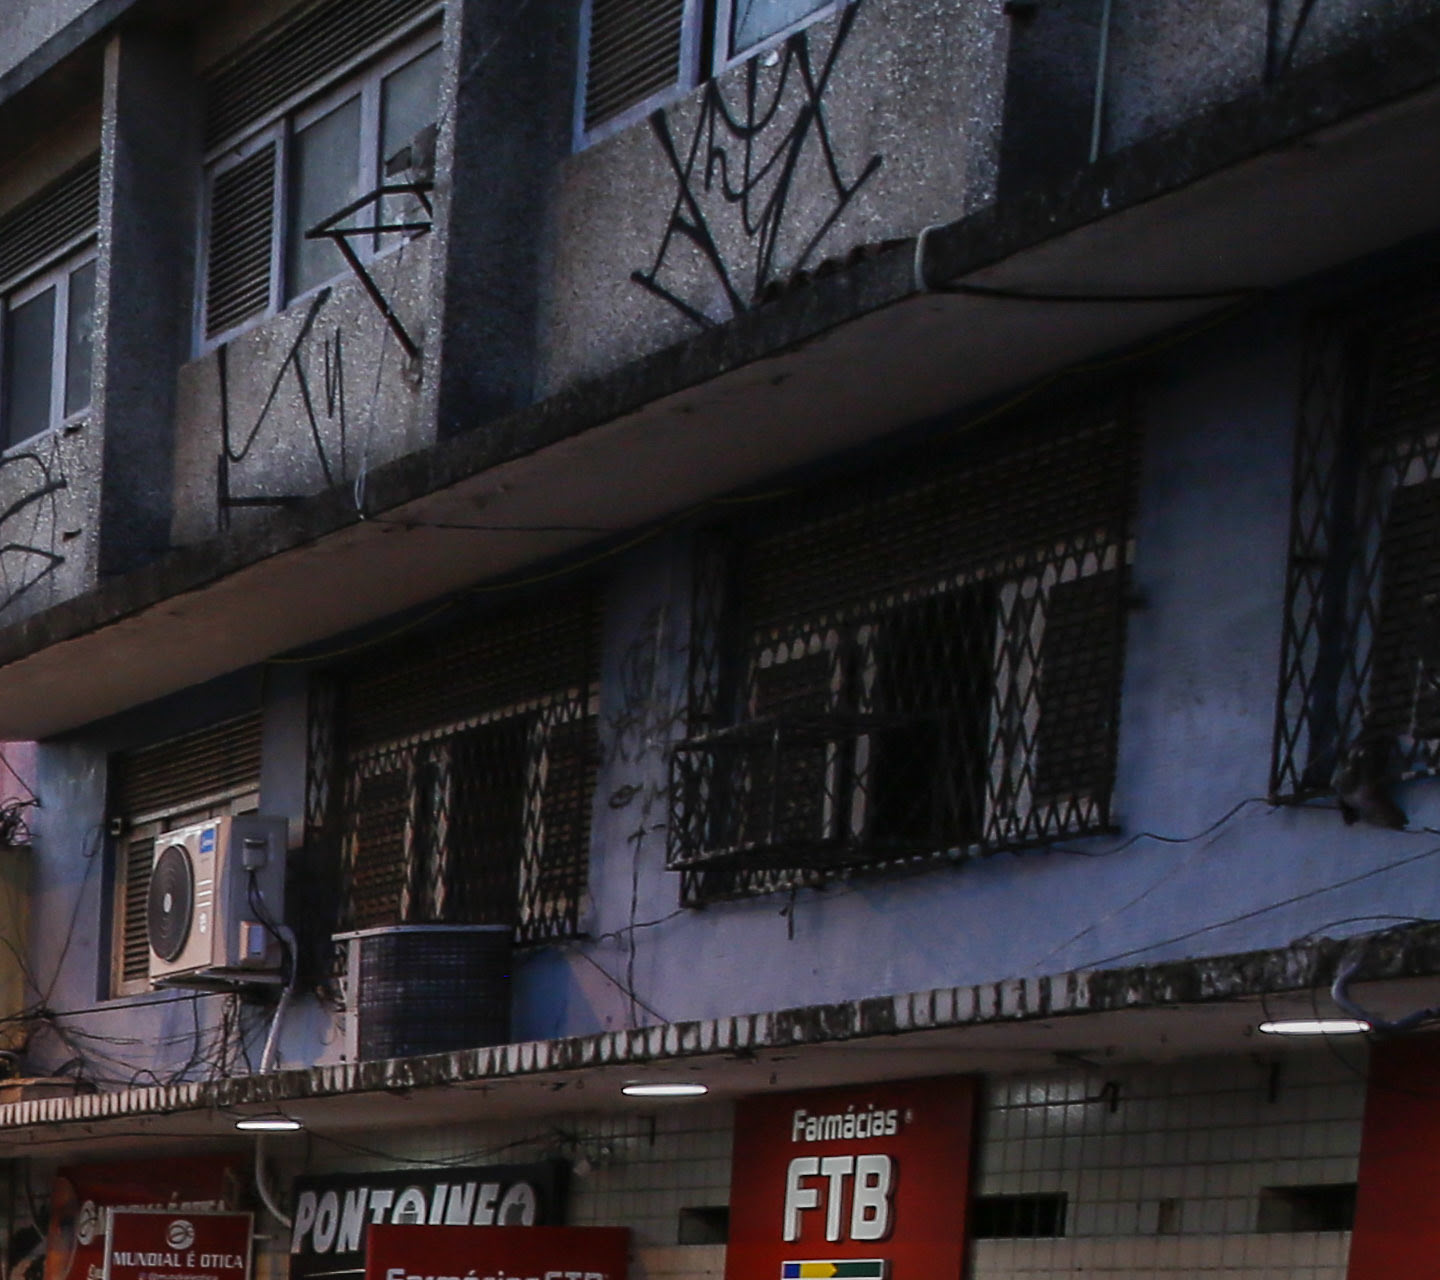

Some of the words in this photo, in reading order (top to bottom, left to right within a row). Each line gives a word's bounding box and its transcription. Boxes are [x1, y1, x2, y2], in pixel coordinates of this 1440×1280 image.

[792, 1104, 898, 1142] Farmácias
[783, 1154, 892, 1242] FTB
[113, 1252, 181, 1267] MUNDIAL
[200, 1254, 243, 1269] OTICA
